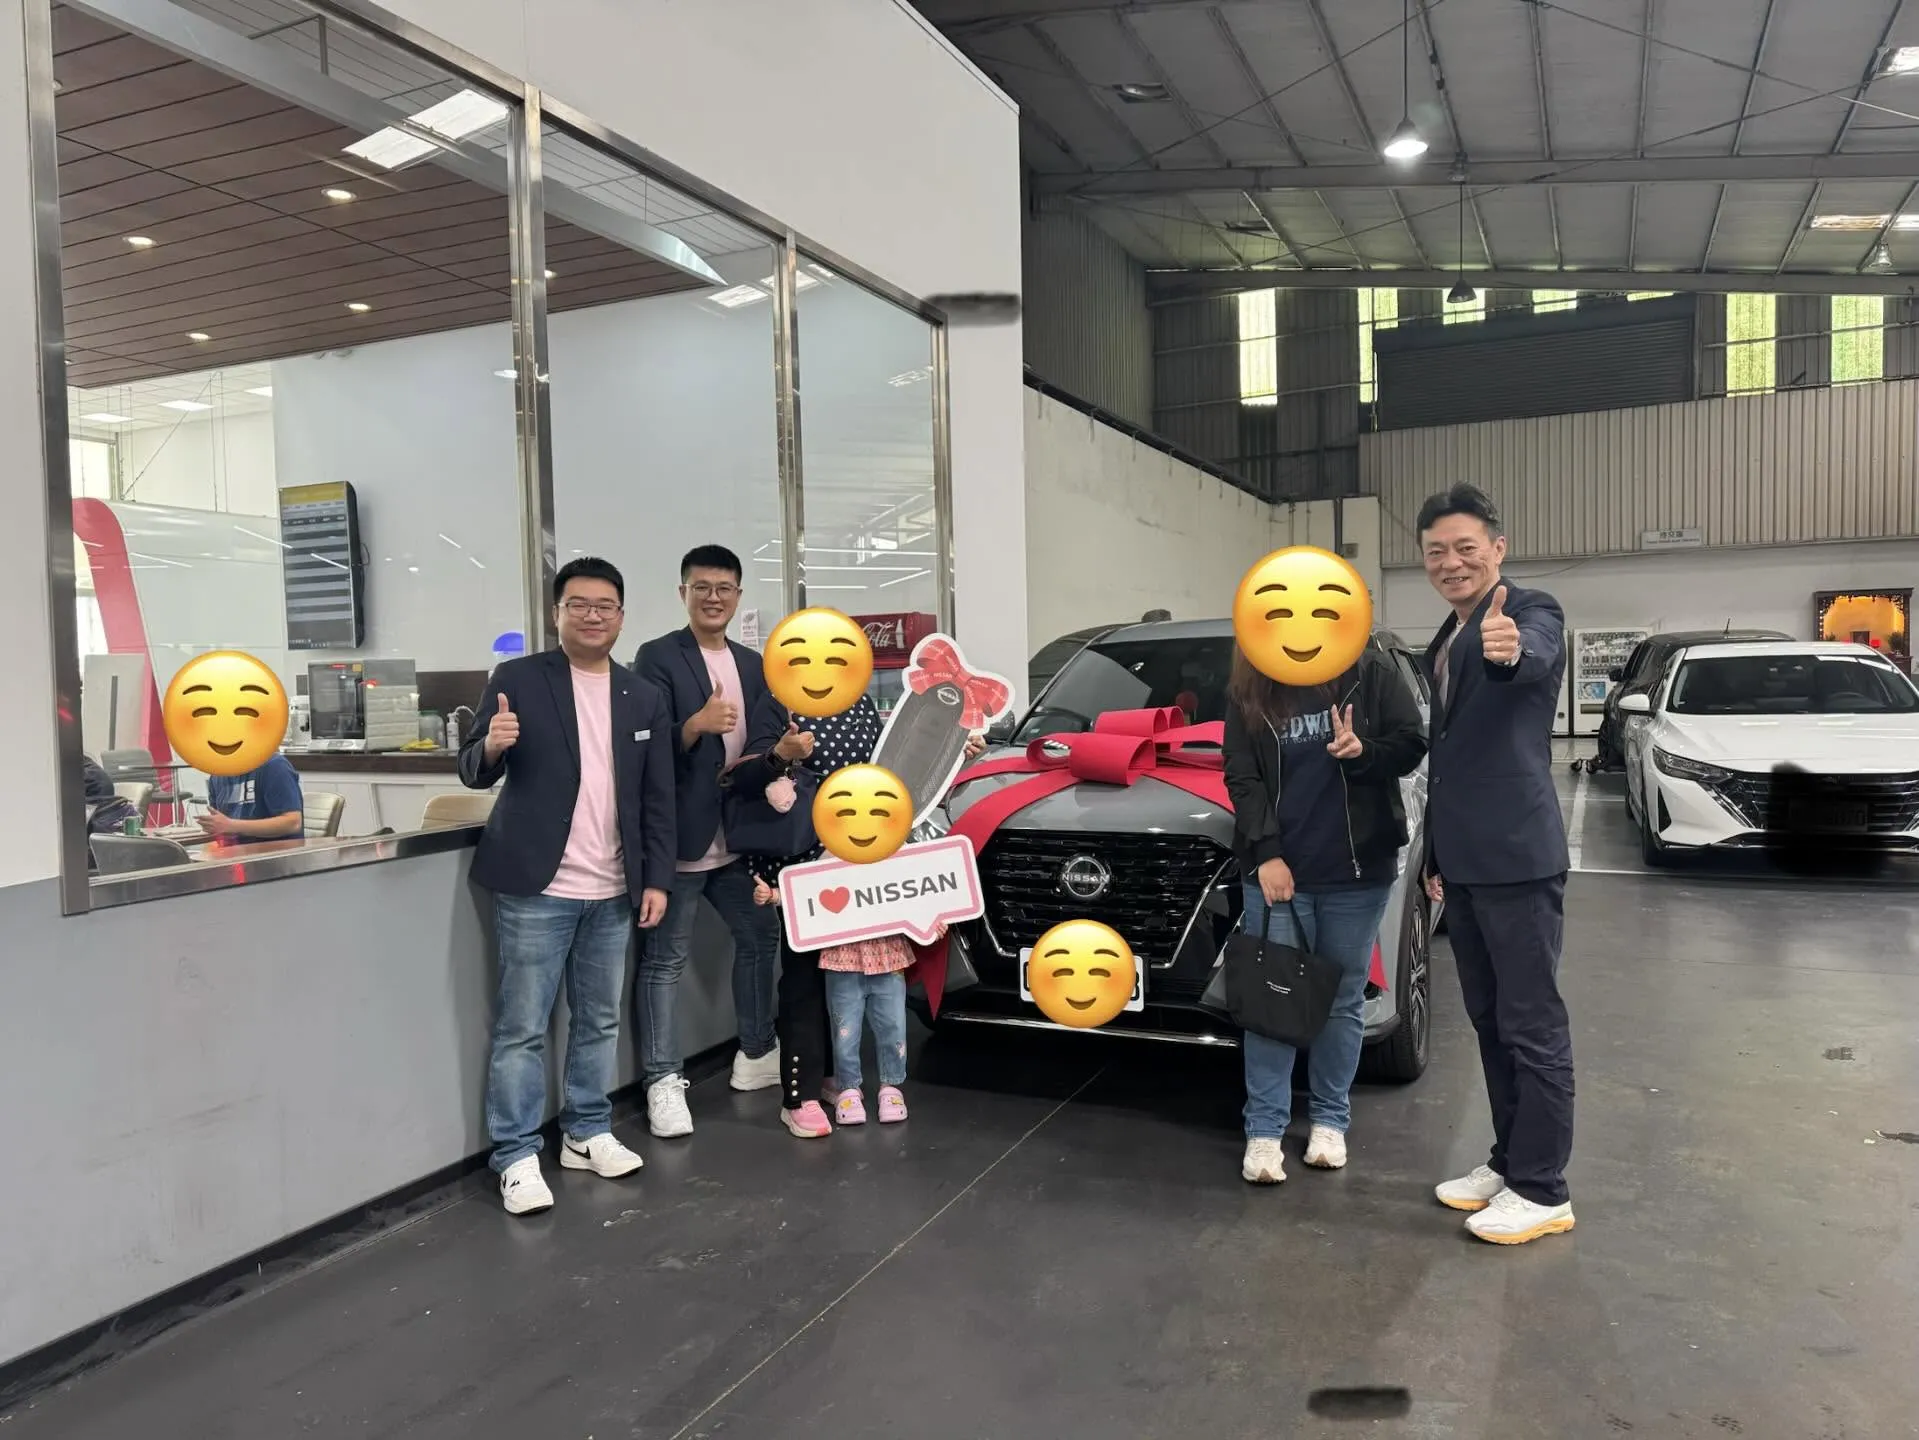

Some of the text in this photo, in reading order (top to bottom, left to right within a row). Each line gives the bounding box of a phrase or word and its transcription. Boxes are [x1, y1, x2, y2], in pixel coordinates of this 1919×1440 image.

[1062, 873, 1110, 884] NISSAN
[807, 871, 958, 917] I NISSAN
